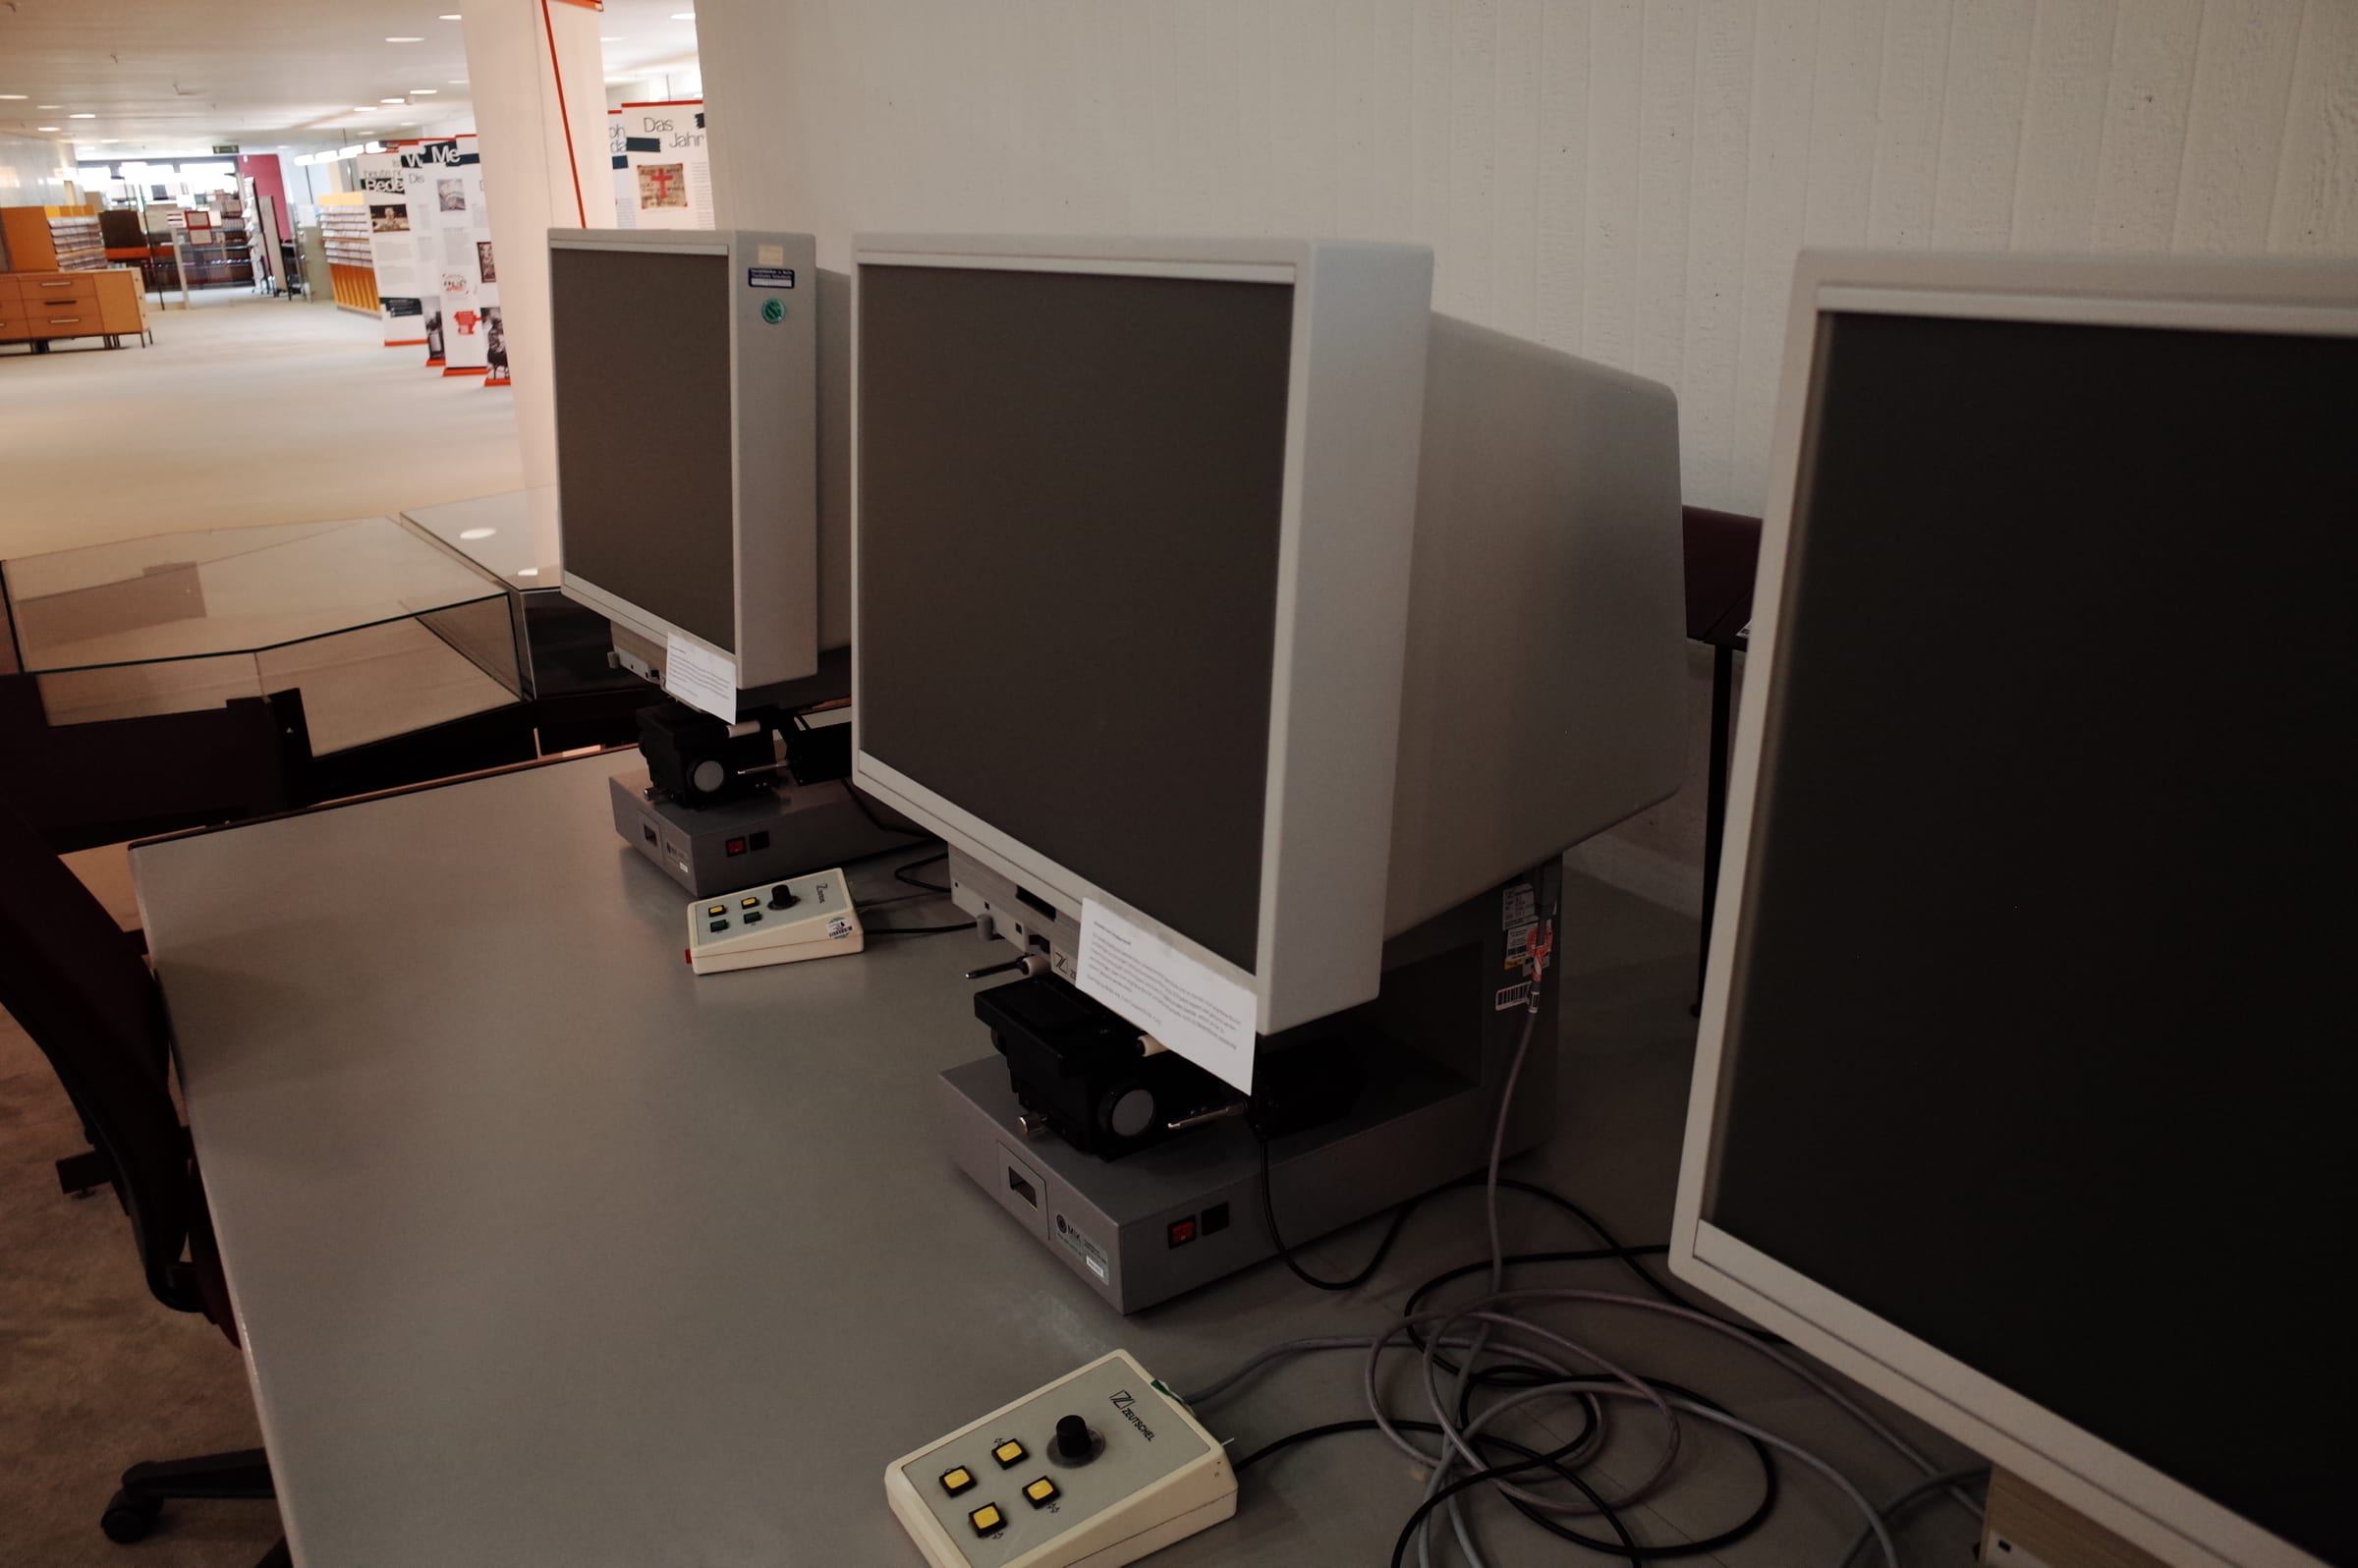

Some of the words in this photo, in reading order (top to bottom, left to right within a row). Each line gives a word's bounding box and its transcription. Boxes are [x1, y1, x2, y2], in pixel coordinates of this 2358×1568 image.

[644, 117, 674, 133] Das
[669, 133, 704, 148] Jahr
[1122, 1407, 1154, 1442] ZEUTSCHEL
